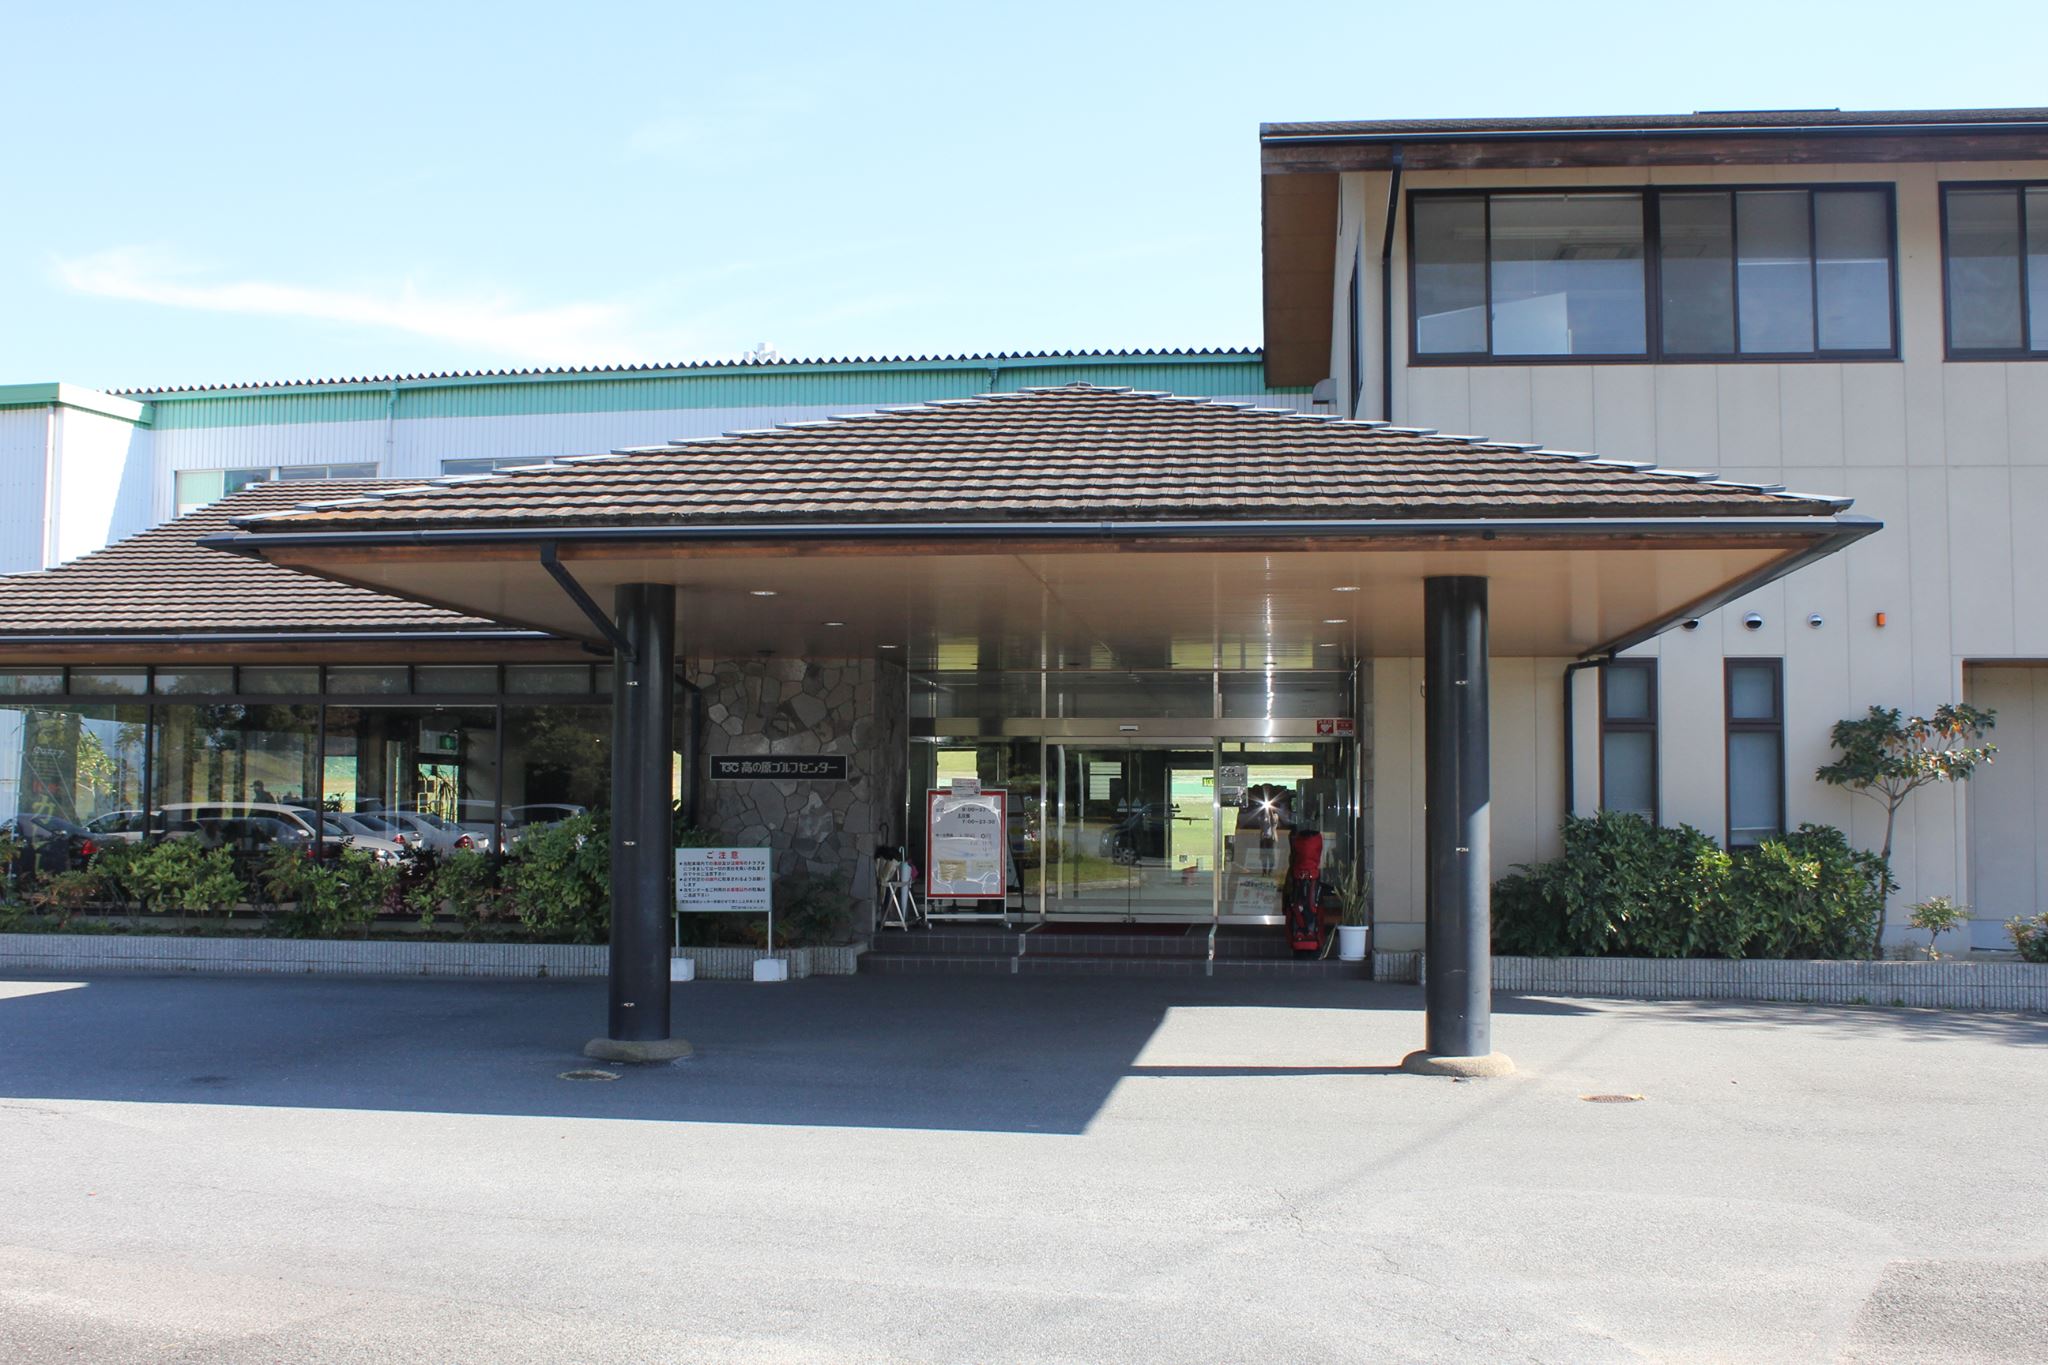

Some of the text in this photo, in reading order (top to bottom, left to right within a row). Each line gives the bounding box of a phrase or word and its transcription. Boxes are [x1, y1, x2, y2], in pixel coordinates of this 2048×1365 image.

[741, 761, 838, 773] 高の原ゴルフセンター
